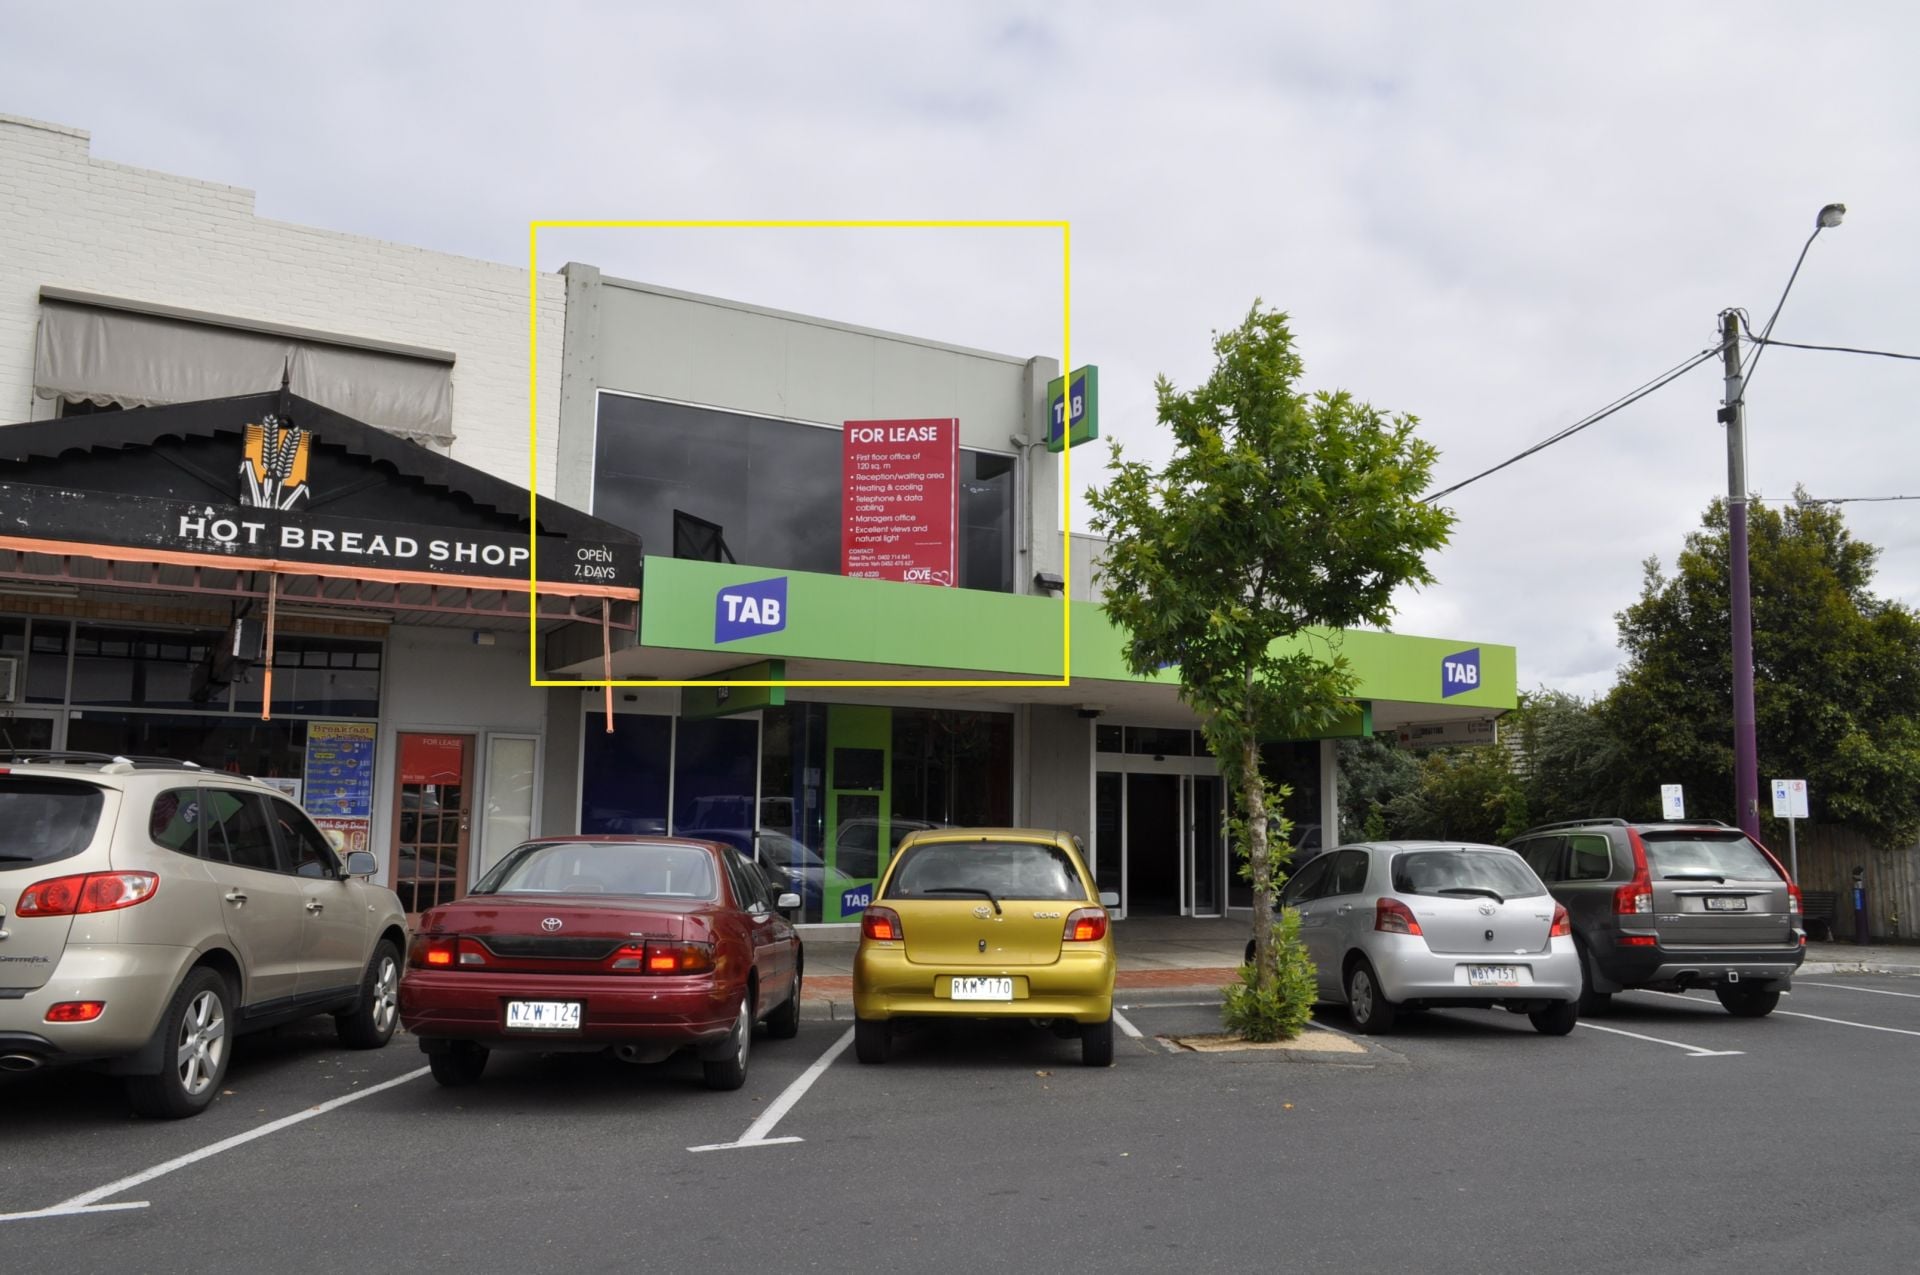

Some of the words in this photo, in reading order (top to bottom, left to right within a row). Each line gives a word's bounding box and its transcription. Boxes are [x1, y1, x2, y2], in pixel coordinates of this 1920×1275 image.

[850, 428, 884, 443] FOR
[889, 427, 937, 442] LEASE
[871, 453, 888, 461] floor
[912, 452, 920, 460] of
[856, 472, 925, 481] Reception/waiting
[926, 472, 945, 480] area
[856, 484, 886, 493] Heating
[894, 483, 923, 492] cooling
[856, 494, 895, 503] Telephone
[896, 494, 902, 502] &
[856, 504, 884, 513] cabling
[855, 515, 893, 524] Managers
[894, 514, 916, 522] office
[855, 526, 889, 534] Excellent
[890, 525, 911, 533] views
[912, 525, 928, 533] and
[178, 515, 266, 545] HOT
[281, 526, 418, 559] BREAD
[429, 540, 530, 566] SHOP
[855, 535, 882, 543] natural
[883, 534, 900, 544] light
[576, 548, 613, 564] OPEN
[584, 565, 616, 580] DAYS
[903, 569, 931, 580] LOVE
[722, 595, 780, 625] TAB
[1445, 662, 1478, 685] TAB
[845, 892, 870, 908] TAB
[954, 980, 977, 994] RKM
[988, 980, 1011, 994] 170
[511, 1004, 544, 1021] NZW
[554, 1004, 579, 1021] 124
